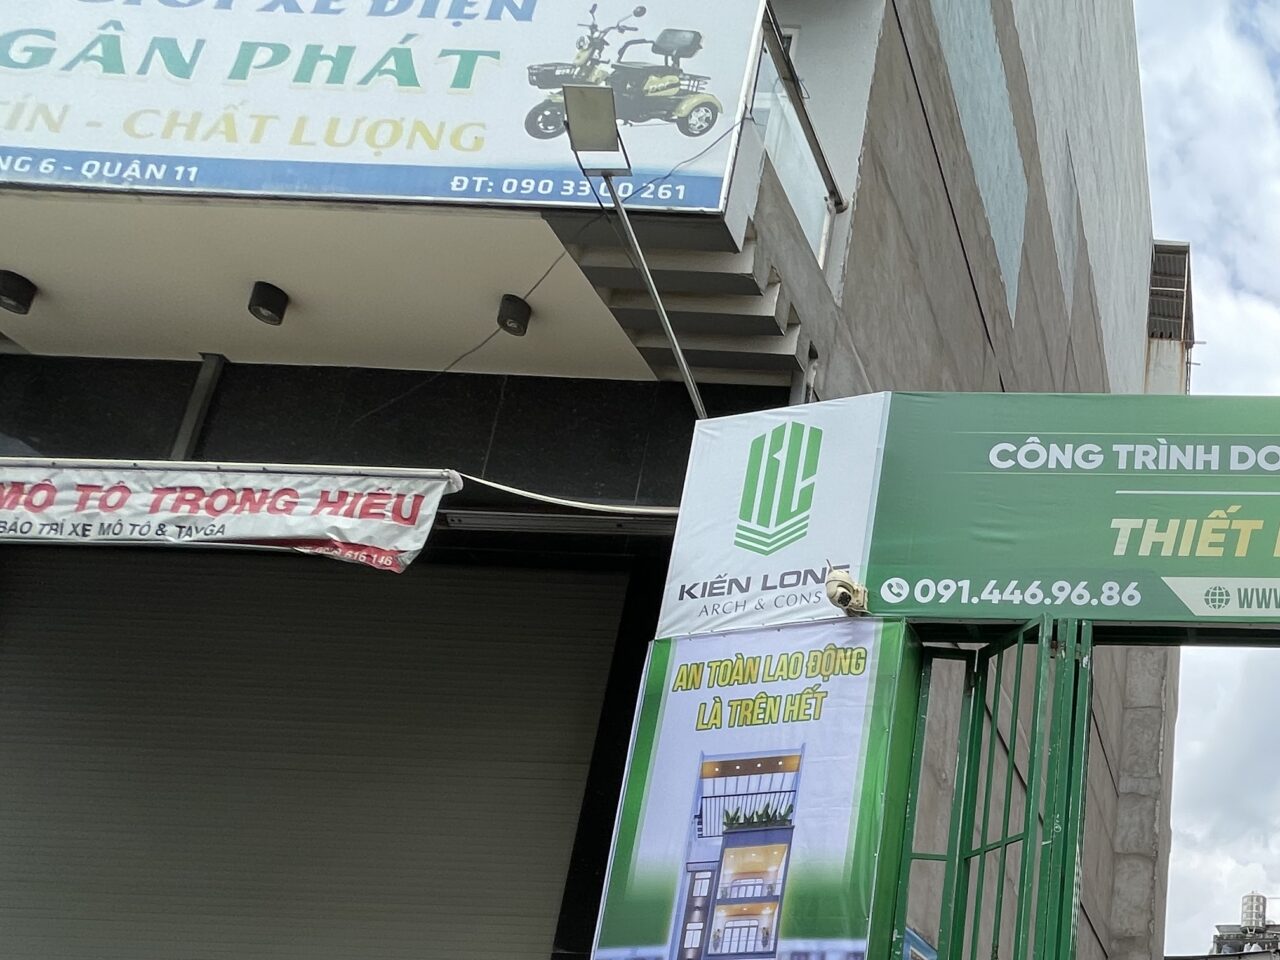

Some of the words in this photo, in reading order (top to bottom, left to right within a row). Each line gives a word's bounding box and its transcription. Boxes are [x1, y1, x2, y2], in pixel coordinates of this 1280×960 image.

[227, 33, 500, 89] PHÁT
[122, 99, 279, 144] CHẤT
[289, 114, 487, 157] LƯỢNG
[39, 158, 57, 174] 6
[81, 160, 167, 184] QUẬN
[174, 166, 198, 183] 11
[450, 175, 494, 193] ĐT:
[501, 178, 553, 195] 090
[640, 183, 685, 200] 261
[988, 436, 1104, 471] CÔNG
[1112, 437, 1220, 472] TRÌNH
[74, 480, 132, 513] TÔ
[69, 523, 93, 537] XE
[98, 519, 124, 536] MÔ
[1110, 505, 1263, 558] THIẾT
[678, 573, 751, 601] KIẾN
[698, 600, 747, 617] ARCH
[754, 598, 765, 611] &
[774, 590, 822, 608] CONS
[914, 579, 1141, 607] 091.446.96.86
[672, 661, 704, 692] AN
[707, 652, 762, 688] TOÀN
[762, 651, 804, 683] LAO
[805, 643, 867, 682] ĐỘNG
[695, 696, 723, 731] LÀ
[727, 691, 782, 728] TRÊN
[783, 683, 827, 722] HẾT
